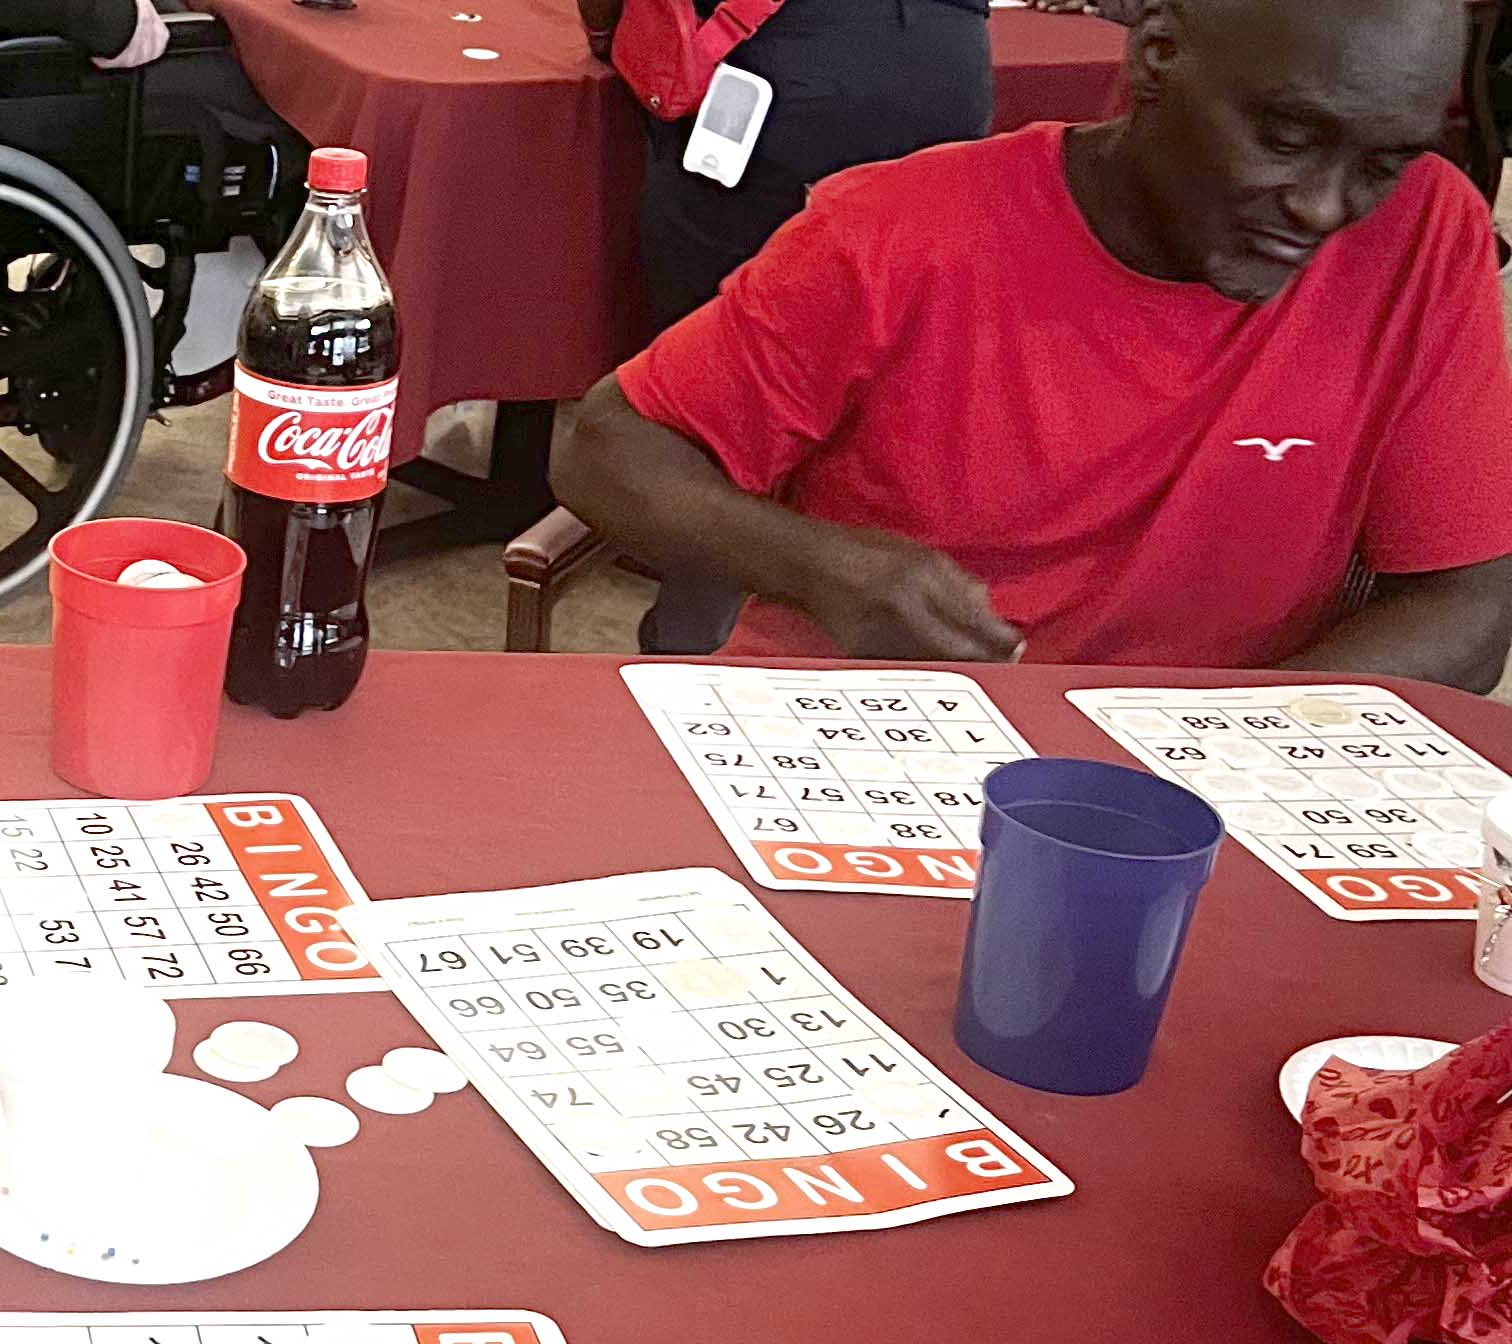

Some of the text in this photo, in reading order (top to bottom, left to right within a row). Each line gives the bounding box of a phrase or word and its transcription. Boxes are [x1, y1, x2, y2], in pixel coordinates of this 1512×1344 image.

[267, 390, 303, 405] Great
[794, 696, 959, 713] 4 25 33
[684, 721, 986, 744] 1 30 34 62
[1180, 711, 1407, 731] 13 39 58
[703, 752, 822, 771] 58 75
[1155, 742, 1450, 761] 11 25 42 62
[729, 783, 983, 807] 18 35 57 71
[752, 816, 943, 840] 38 67
[1301, 808, 1418, 825] 36 50
[1281, 843, 1399, 859] 59 71
[9, 848, 50, 872] 22
[38, 919, 80, 945] 53
[75, 812, 185, 981] 10 25 41 57 72
[169, 841, 272, 976] 26 42 50 66
[419, 928, 685, 973] 19 39 51 67
[448, 966, 788, 1019] 1 35 50 66
[487, 1009, 848, 1064] 13 30 55 64
[530, 1053, 898, 1109] 11 25 45 74
[655, 1109, 877, 1153] 26 42 58
